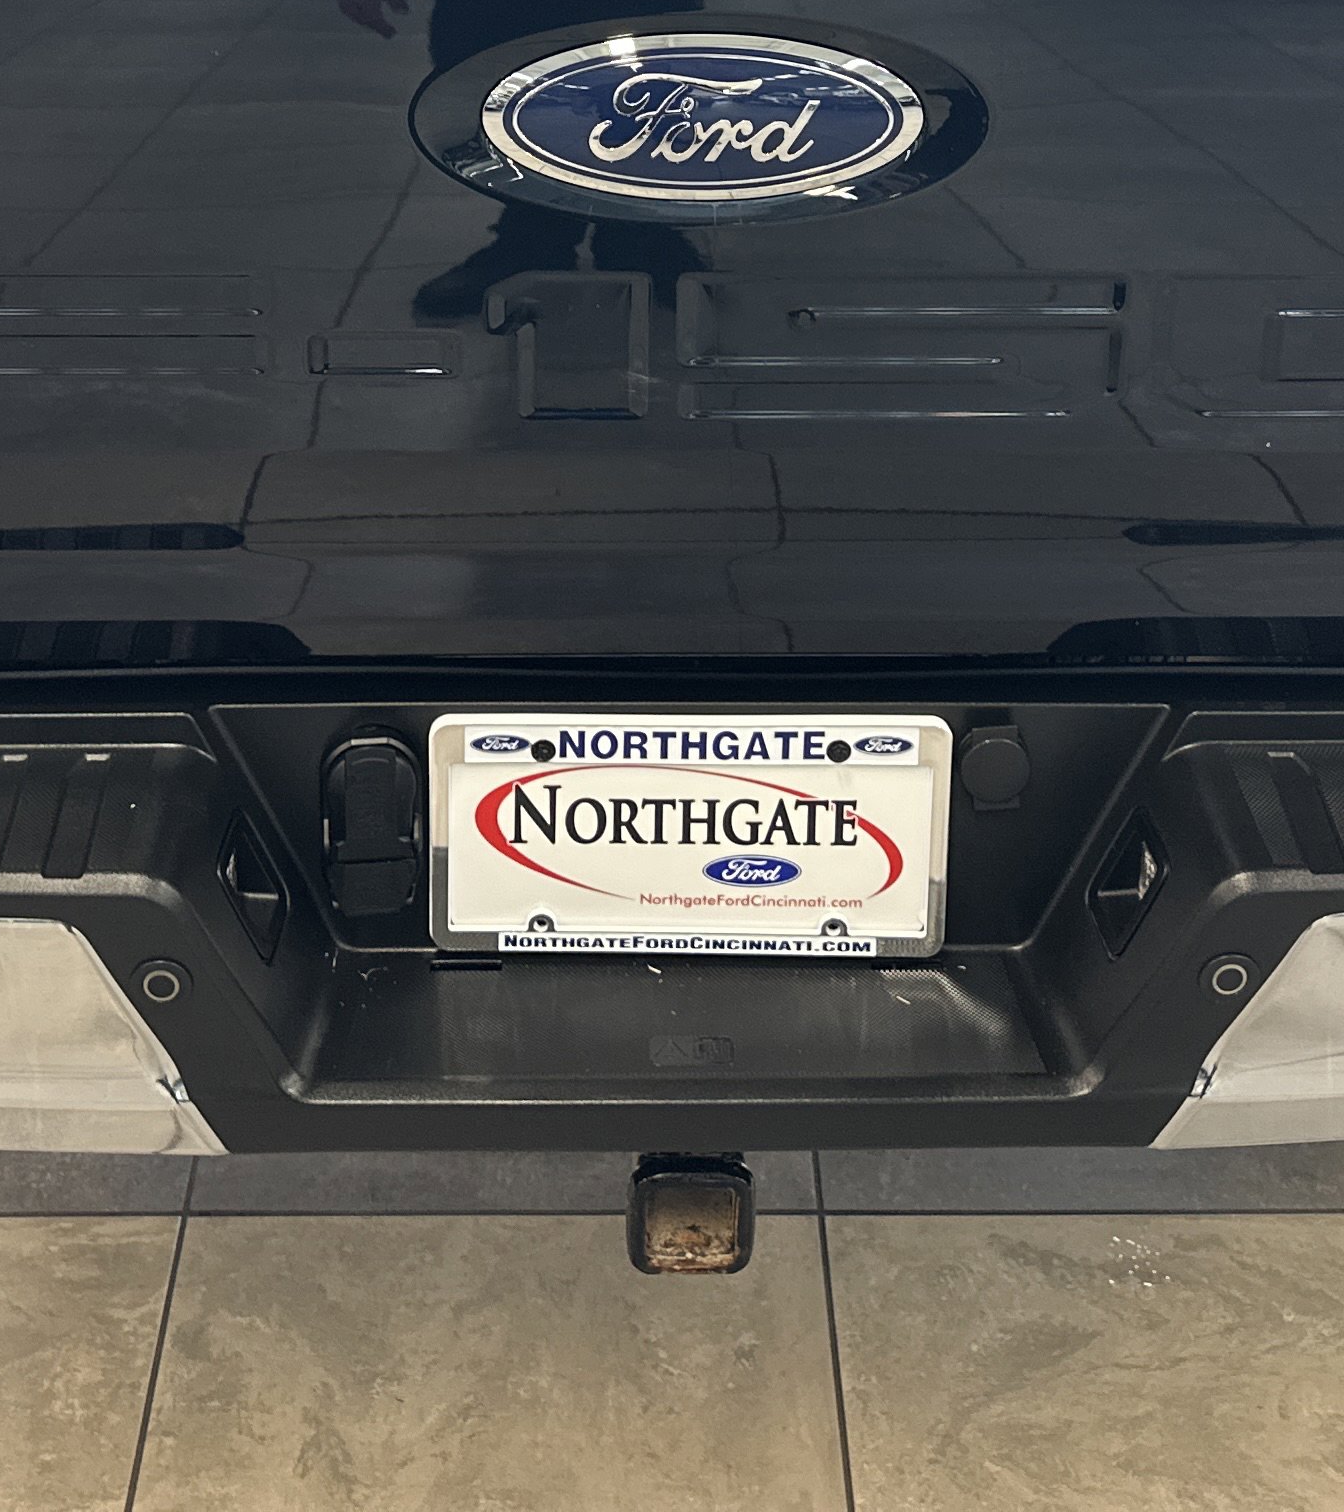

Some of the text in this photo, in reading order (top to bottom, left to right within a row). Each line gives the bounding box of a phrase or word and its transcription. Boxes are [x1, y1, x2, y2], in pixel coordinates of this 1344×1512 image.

[588, 72, 821, 164] Ford
[559, 730, 825, 761] NORTHGATE
[509, 784, 858, 847] NORTHGATE
[721, 858, 782, 881] Ford
[639, 892, 863, 908] NorthgateFordCincinnati.com
[504, 935, 871, 953] NORTHGATEFORDCINCINNATI.COM
